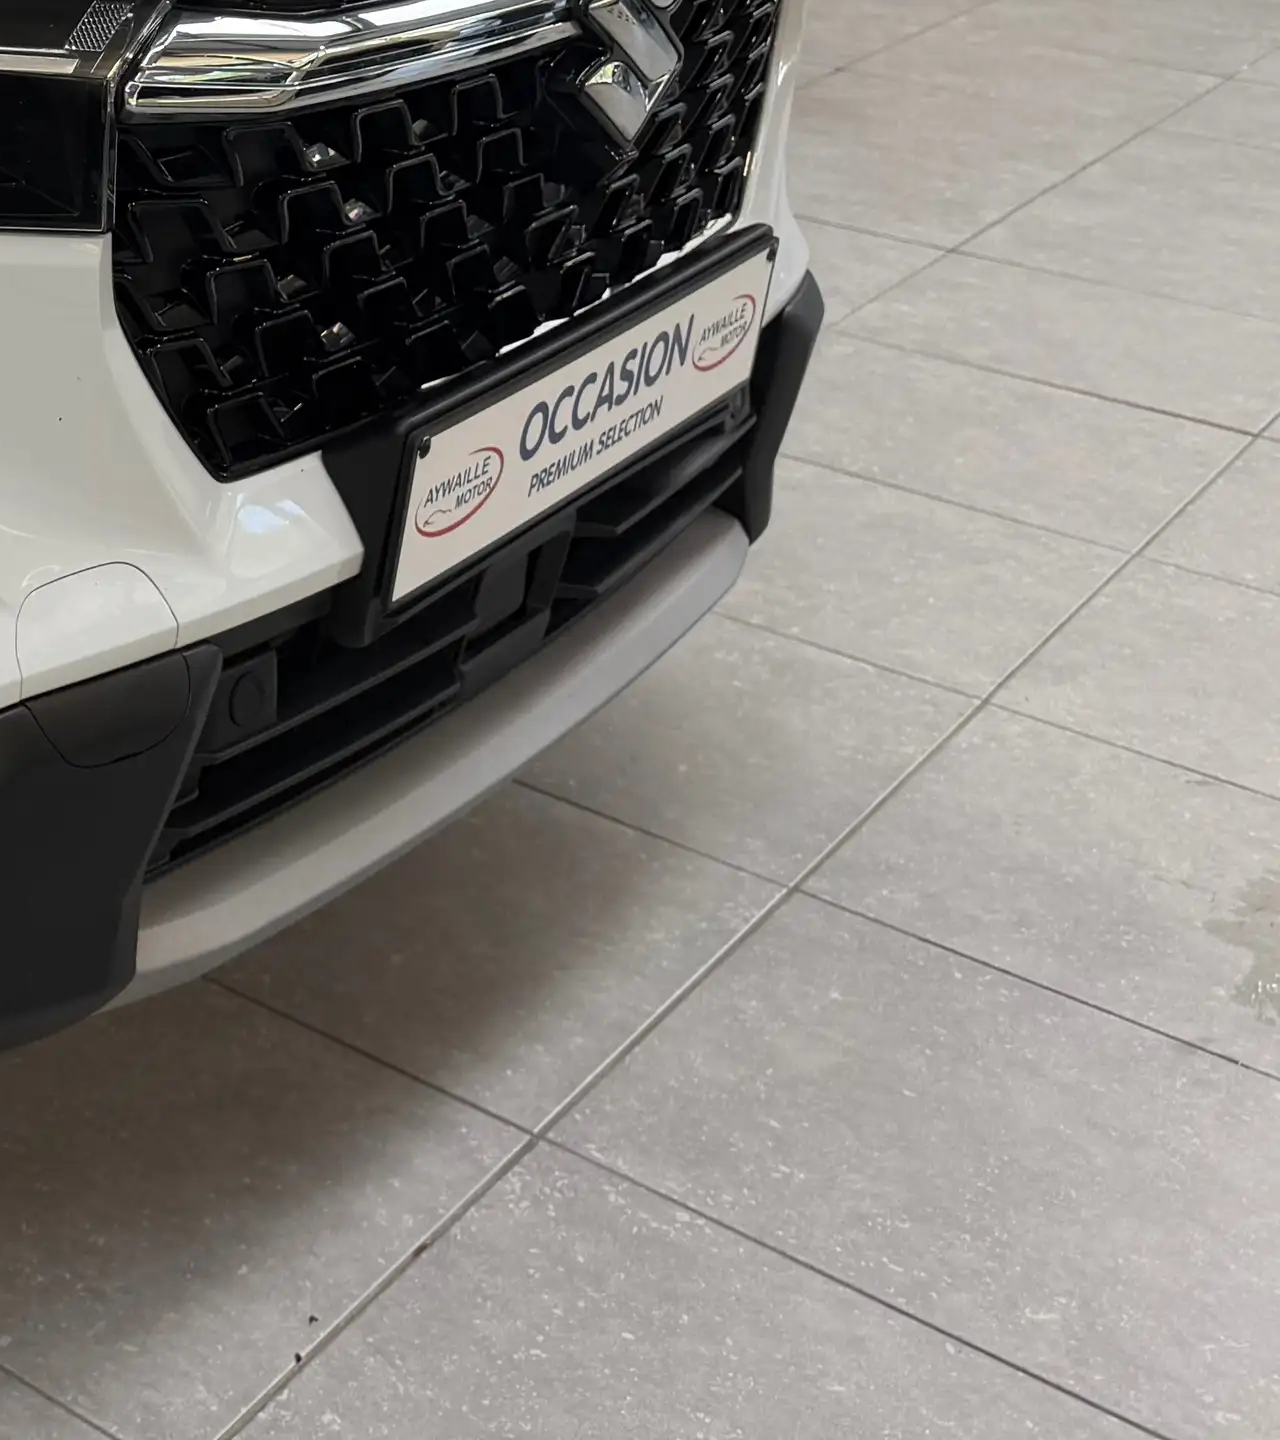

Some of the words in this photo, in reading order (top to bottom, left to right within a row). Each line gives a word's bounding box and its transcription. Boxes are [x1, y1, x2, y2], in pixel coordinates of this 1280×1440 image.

[519, 313, 694, 462] OCCASION
[424, 455, 491, 508] AYWAILLE
[527, 439, 594, 498] PREMIUM
[595, 394, 663, 456] SELECTION
[454, 476, 493, 510] MOTOR
